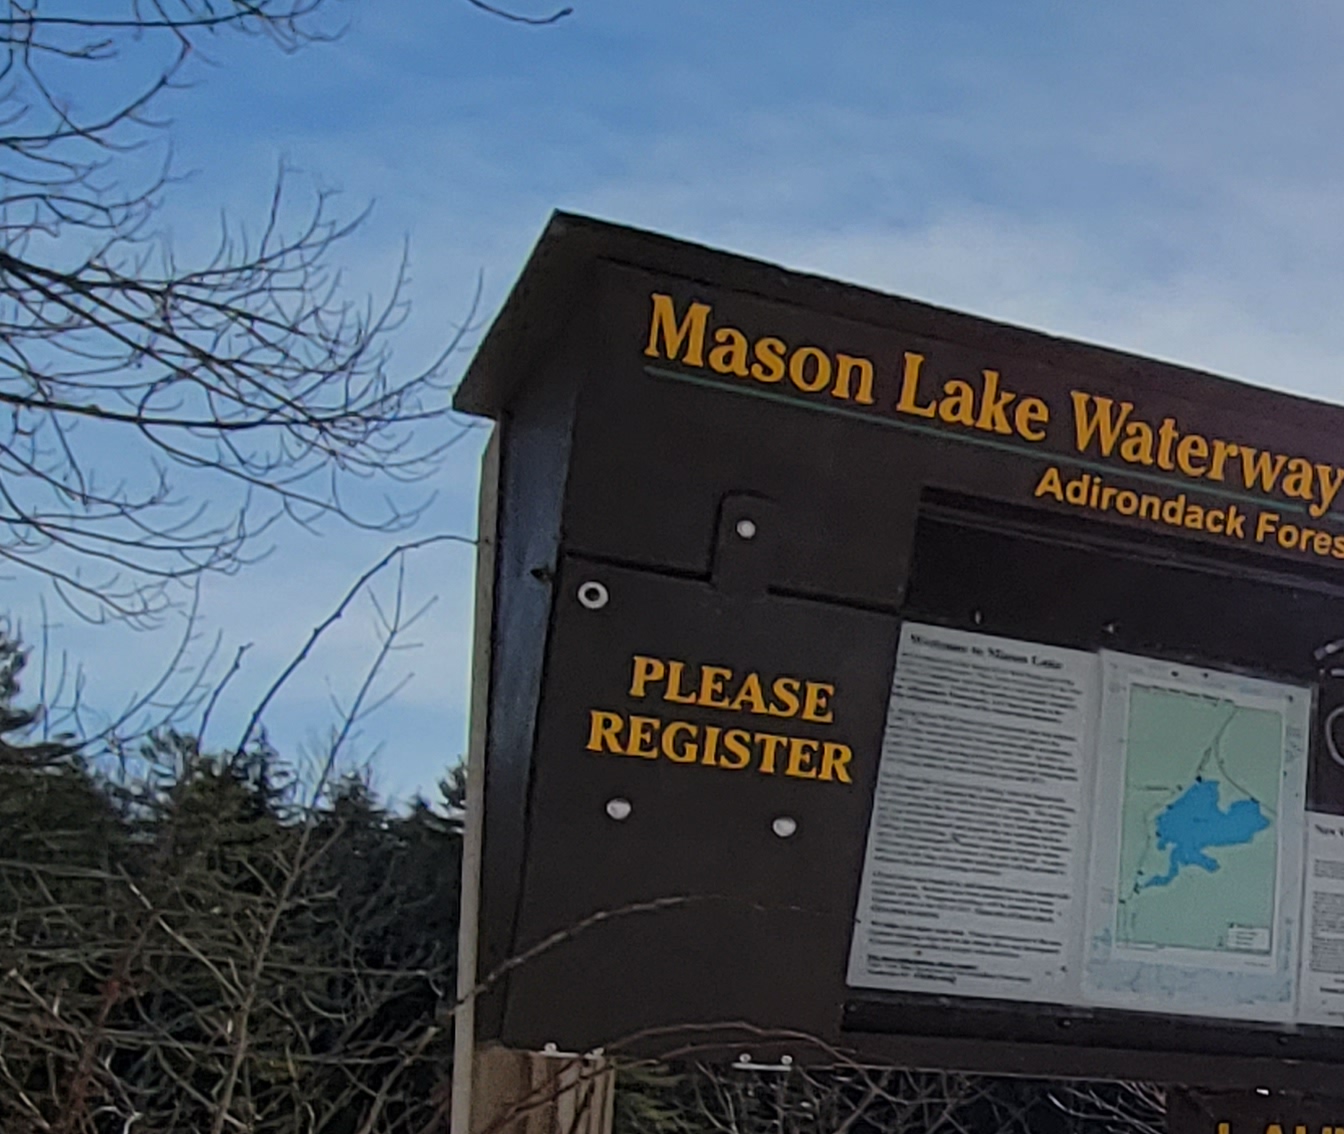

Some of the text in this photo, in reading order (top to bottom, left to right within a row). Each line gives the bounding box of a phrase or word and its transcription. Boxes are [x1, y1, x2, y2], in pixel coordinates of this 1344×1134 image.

[643, 293, 877, 407] Mason
[895, 351, 1050, 442] Lake
[1034, 466, 1246, 540] Adirondack
[629, 655, 836, 724] PLEASE
[585, 709, 854, 784] REGISTER
